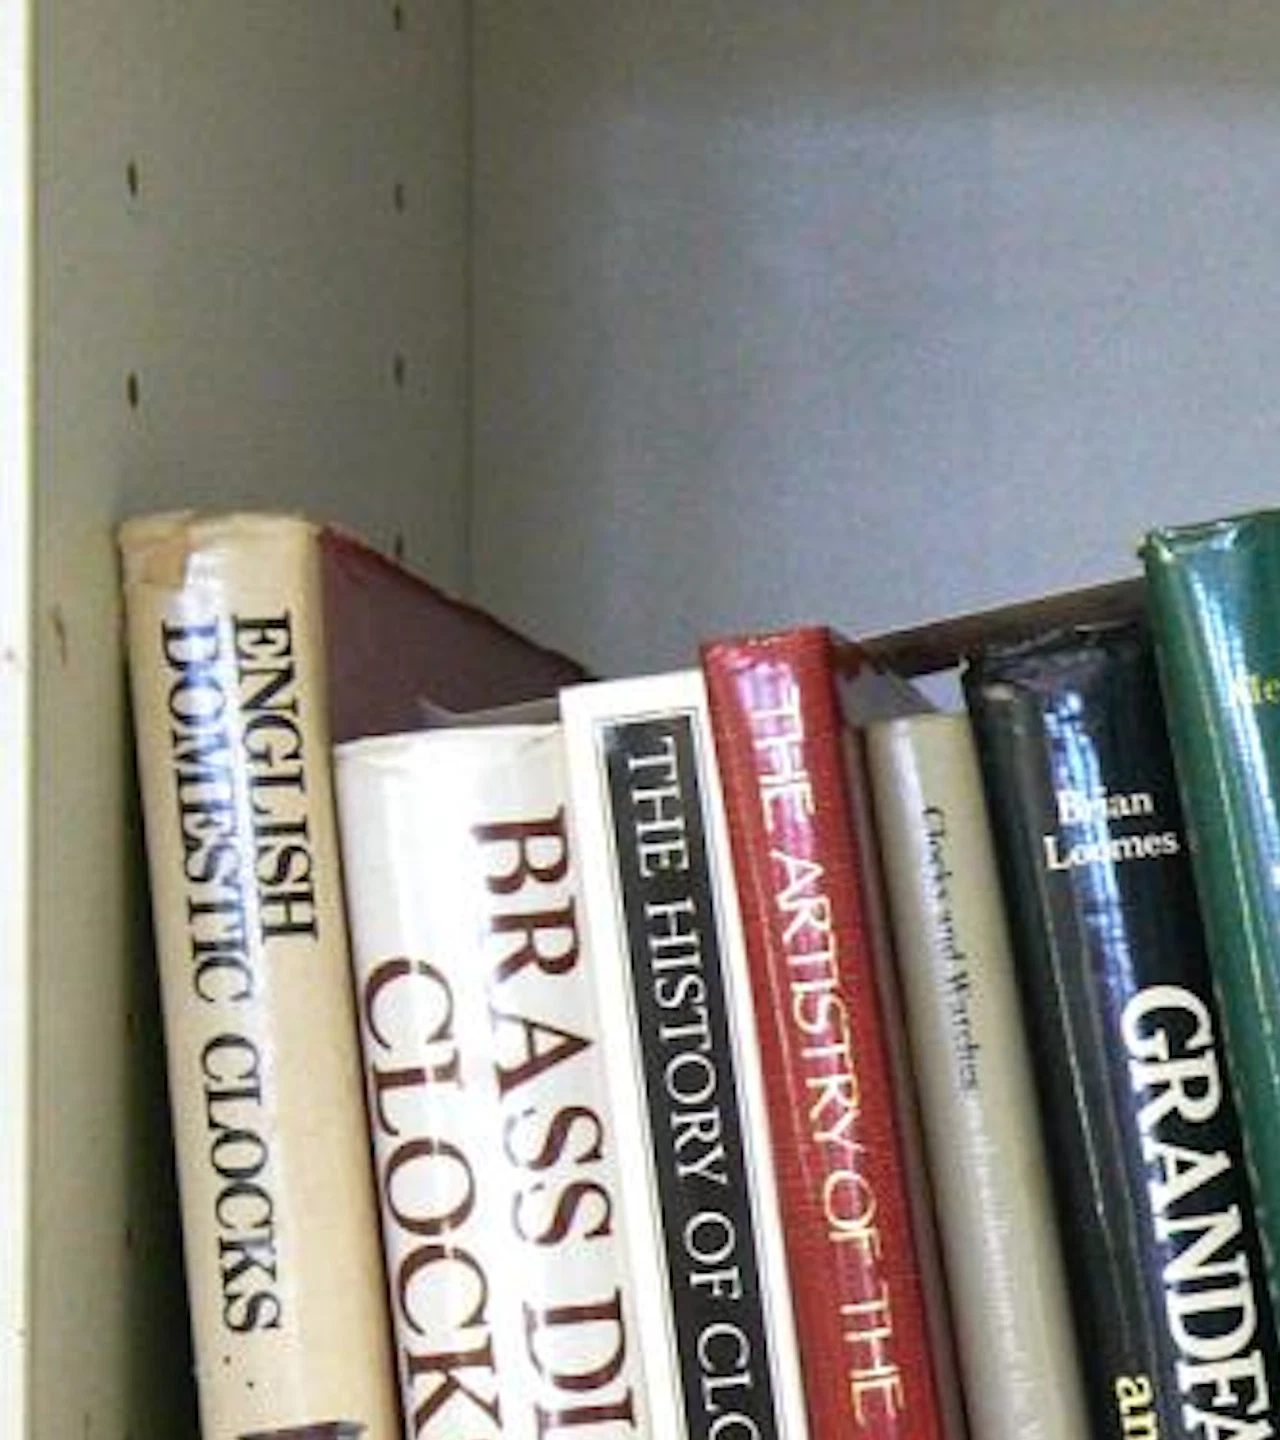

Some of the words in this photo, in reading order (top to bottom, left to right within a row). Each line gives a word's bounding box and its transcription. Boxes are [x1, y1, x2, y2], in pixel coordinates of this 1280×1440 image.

[162, 621, 257, 1002] DOMESTIC
[232, 611, 318, 945] ENGLISH
[626, 735, 689, 878] THE
[1042, 832, 1181, 872] Loomes
[1056, 785, 1155, 826] Brian
[473, 805, 613, 1247] BRASS
[647, 900, 728, 1187] HISTORY
[769, 849, 864, 1170] ARTISTRY
[922, 804, 959, 899] Clocks
[945, 971, 988, 1091] Watches
[201, 1032, 283, 1336] CLOCKS
[684, 1211, 742, 1301] OF
[823, 1169, 882, 1265] OF
[837, 1291, 905, 1425] THE
